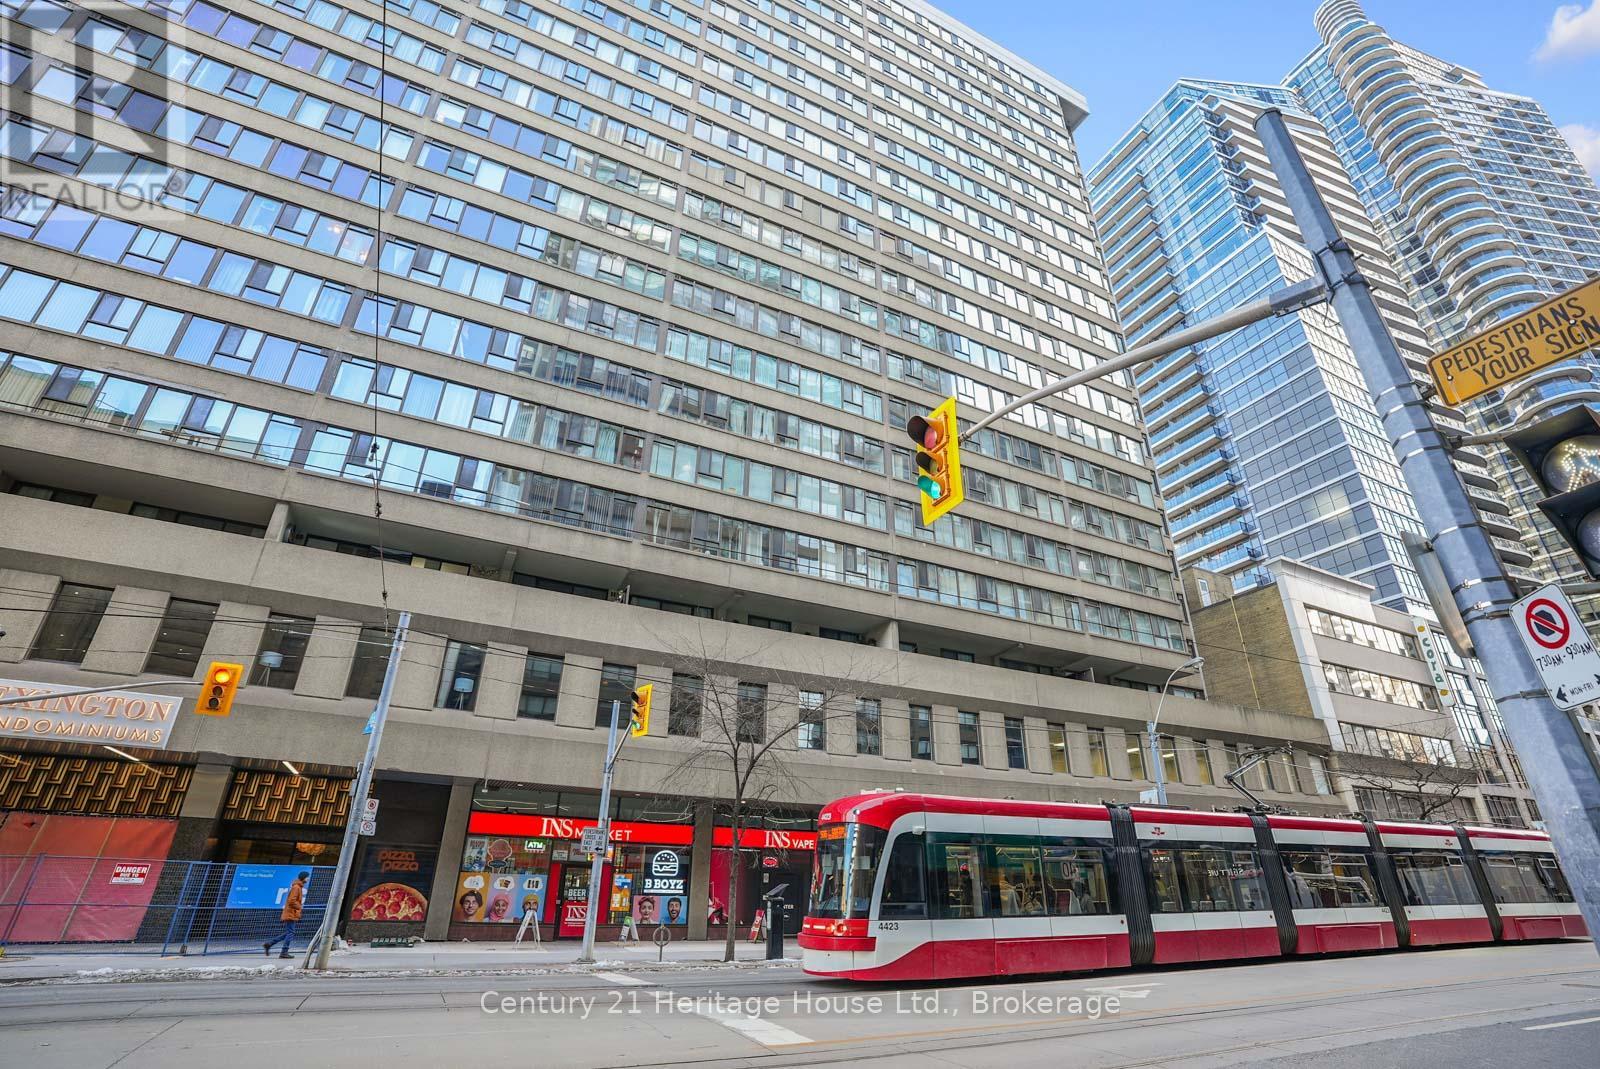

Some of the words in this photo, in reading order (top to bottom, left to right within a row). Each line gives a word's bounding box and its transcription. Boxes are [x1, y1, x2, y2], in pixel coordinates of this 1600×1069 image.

[1440, 297, 1586, 377] PEDESTRIANS
[1473, 347, 1536, 385] YOUR
[1422, 637, 1444, 683] cora
[1569, 682, 1594, 697] MON-FRI
[539, 817, 573, 838] INS
[574, 827, 633, 841] MKET
[527, 841, 543, 849] ATM
[764, 830, 791, 848] INS
[792, 839, 815, 849] VAPE
[376, 849, 416, 862] pizza
[381, 860, 419, 872] pizza
[644, 878, 653, 889] B
[653, 878, 684, 889] BOYZ
[568, 888, 586, 897] BEER
[567, 906, 586, 918] INS
[879, 922, 899, 930] 4423
